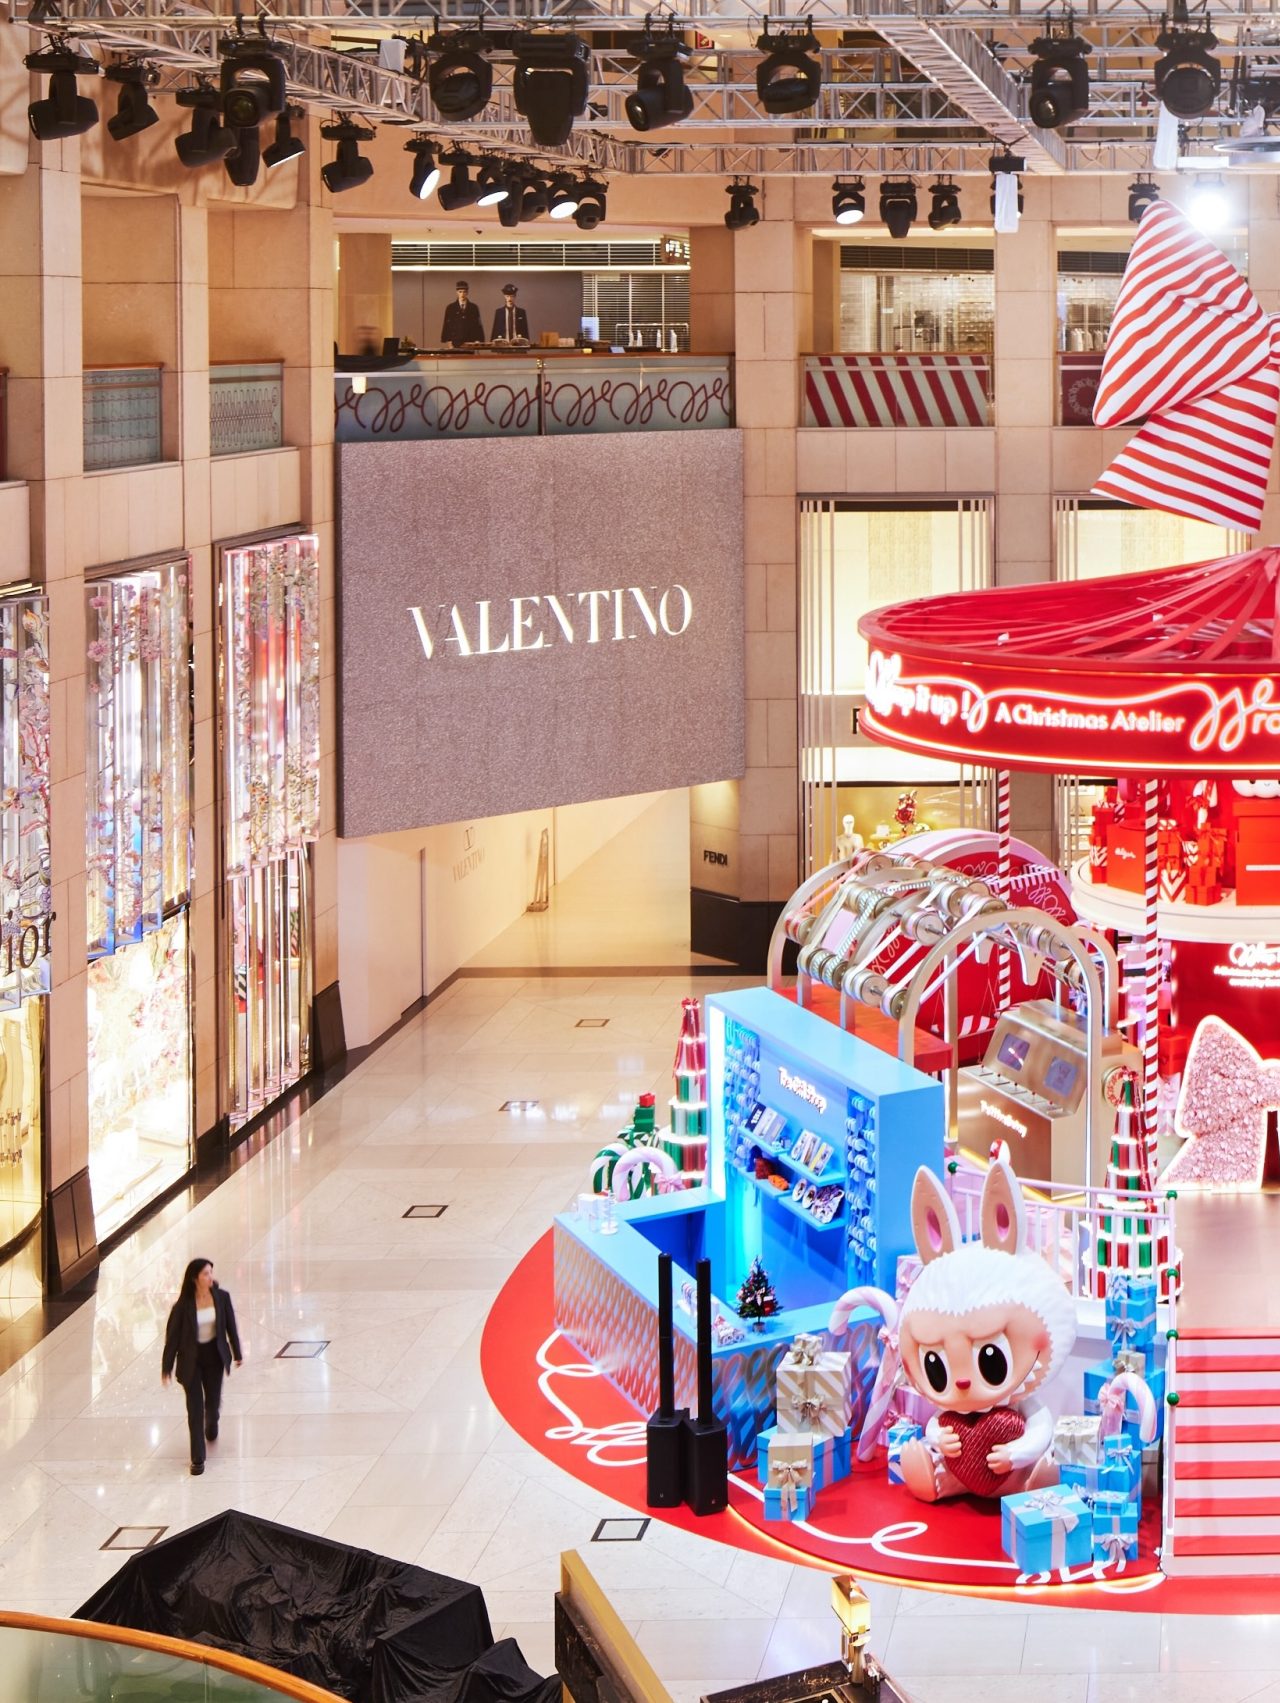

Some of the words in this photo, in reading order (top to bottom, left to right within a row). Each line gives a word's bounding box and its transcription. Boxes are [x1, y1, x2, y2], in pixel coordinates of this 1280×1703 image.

[406, 584, 693, 660] VALENTINO
[930, 693, 958, 726] up
[994, 702, 1011, 724] A
[1011, 704, 1109, 731] Christmas
[1110, 710, 1186, 732] Atelier
[703, 850, 728, 866] FENDI
[0, 911, 57, 977] ior
